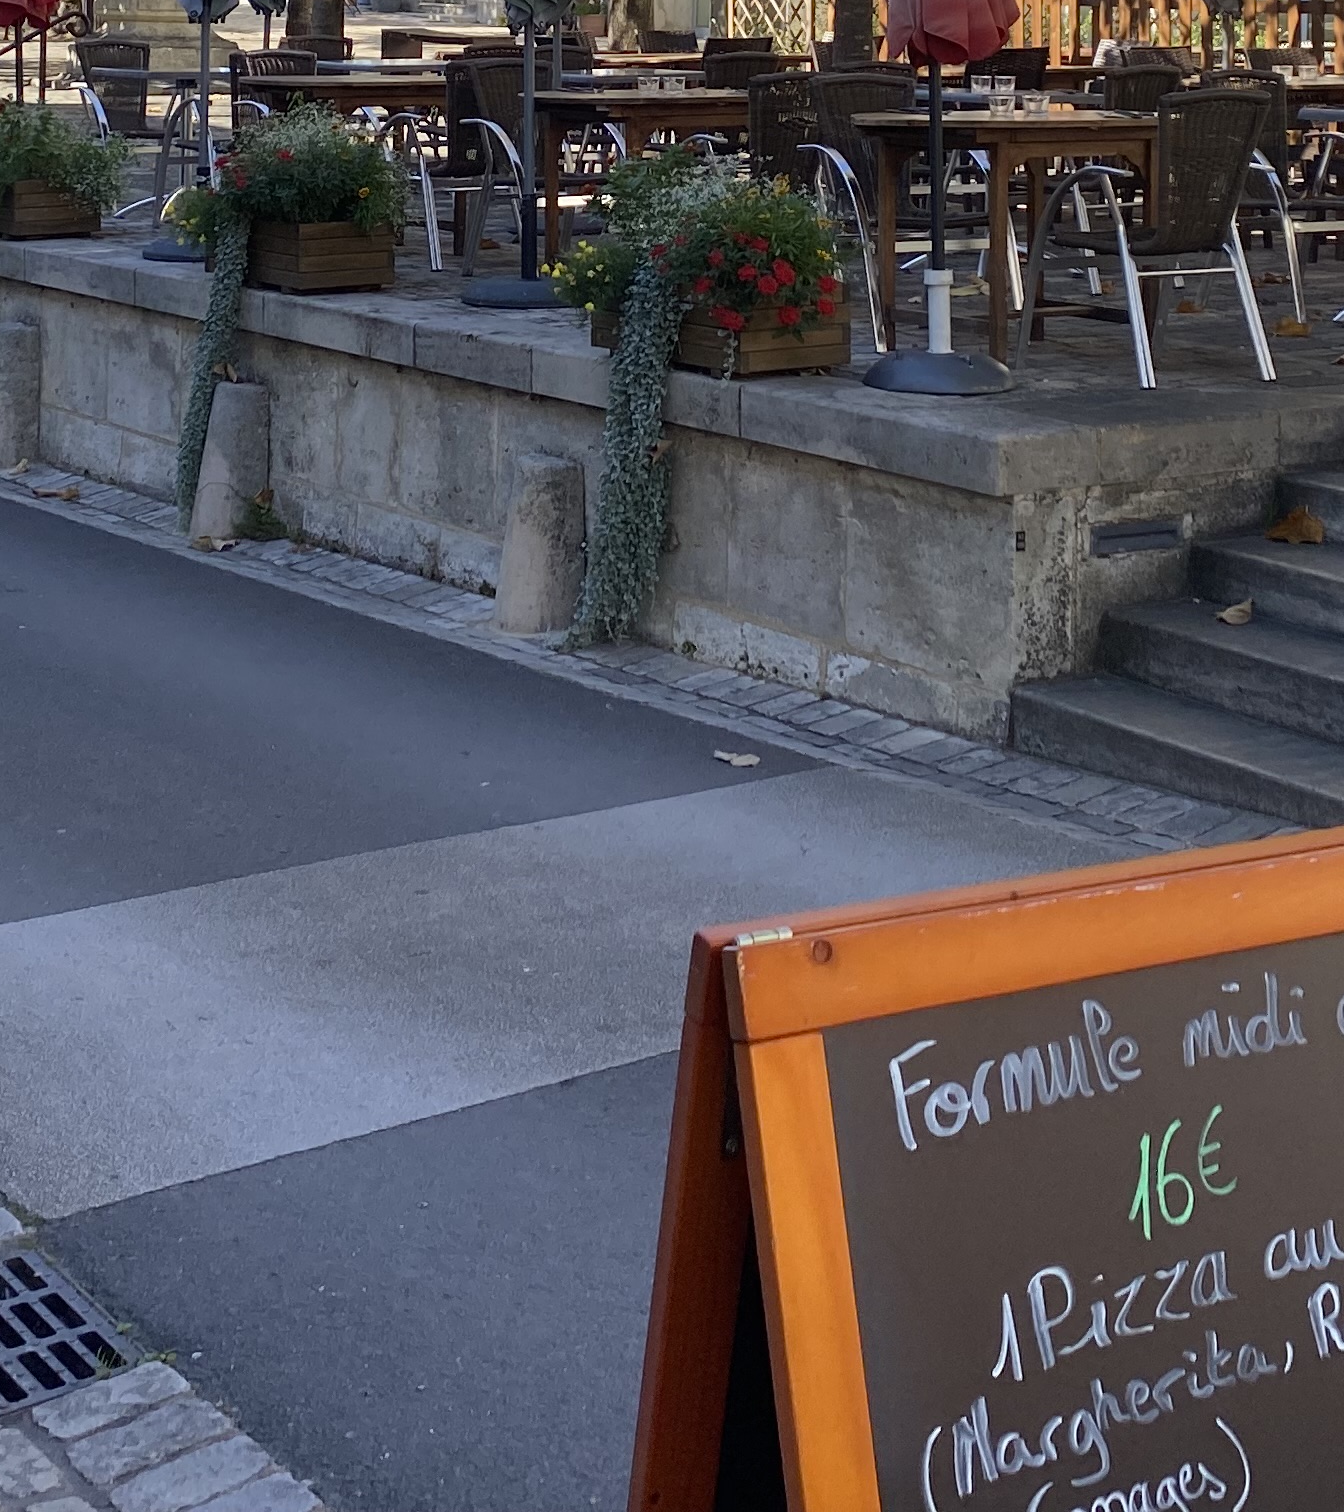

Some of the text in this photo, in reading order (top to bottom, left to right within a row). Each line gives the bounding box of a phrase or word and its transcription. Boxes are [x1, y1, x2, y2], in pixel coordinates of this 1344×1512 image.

[888, 999, 1143, 1152] Formule
[1182, 971, 1308, 1067] midi
[1127, 1103, 1238, 1241] 16€
